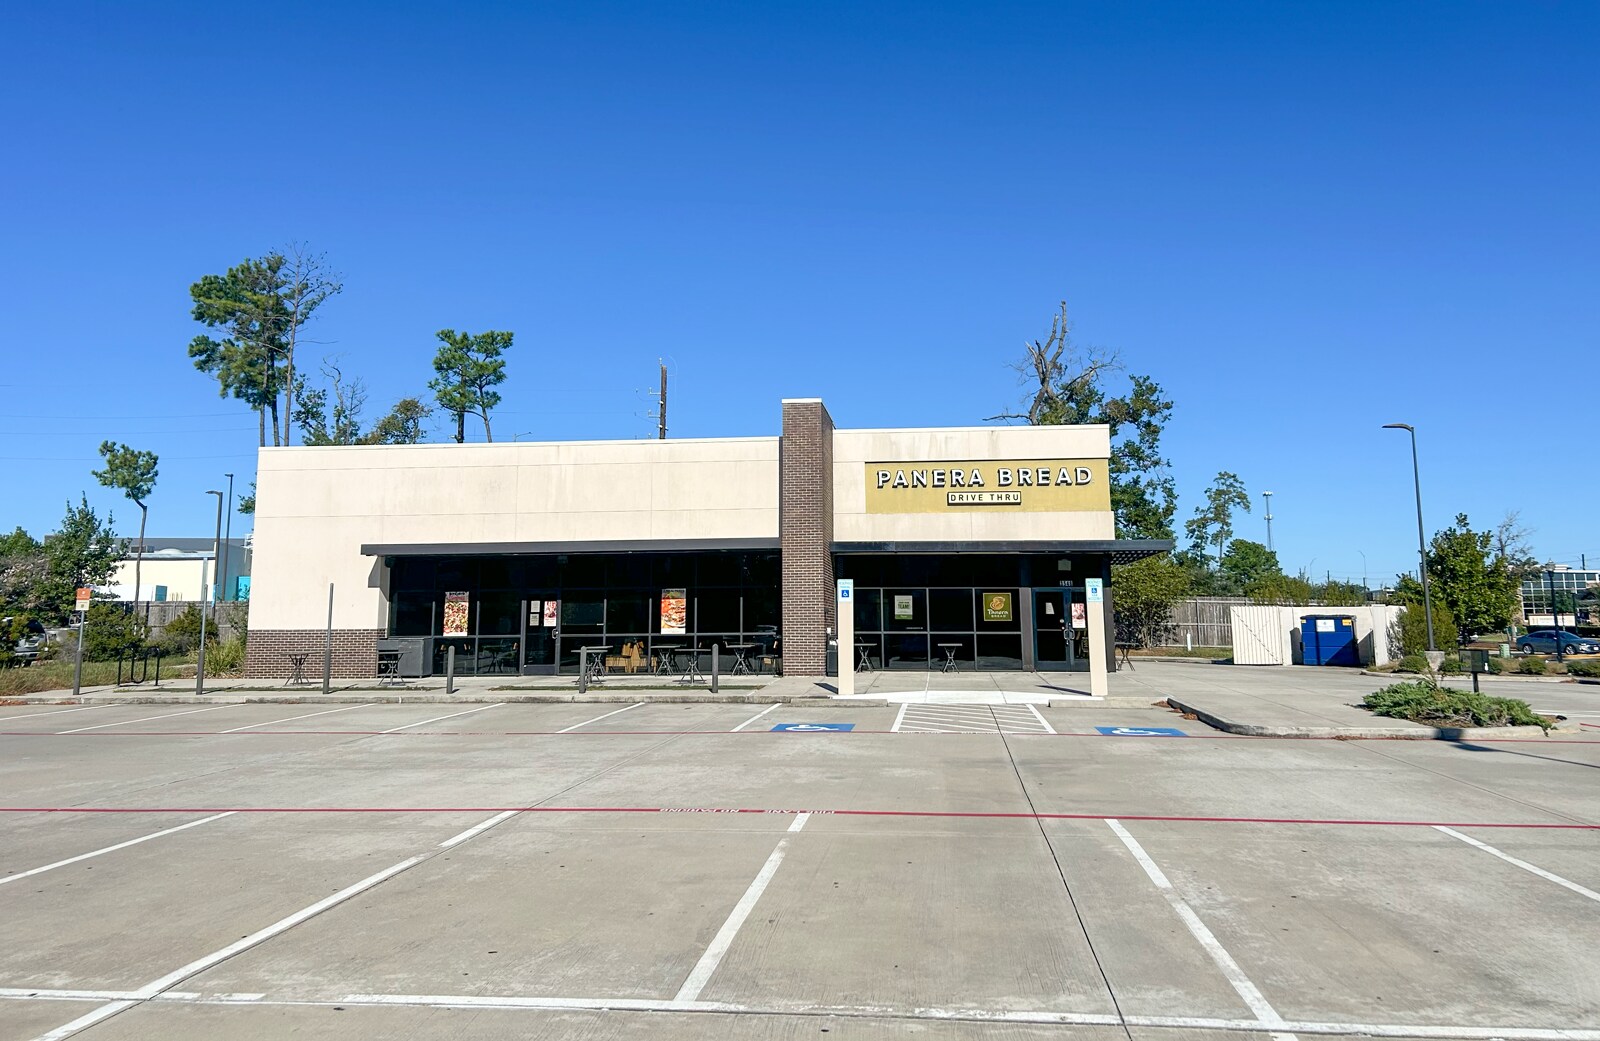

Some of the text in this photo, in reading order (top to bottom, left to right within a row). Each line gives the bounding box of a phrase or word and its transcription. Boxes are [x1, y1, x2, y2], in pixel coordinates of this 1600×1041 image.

[877, 466, 1093, 489] PANERA BREAD
[950, 493, 1019, 502] DRIVE THRU
